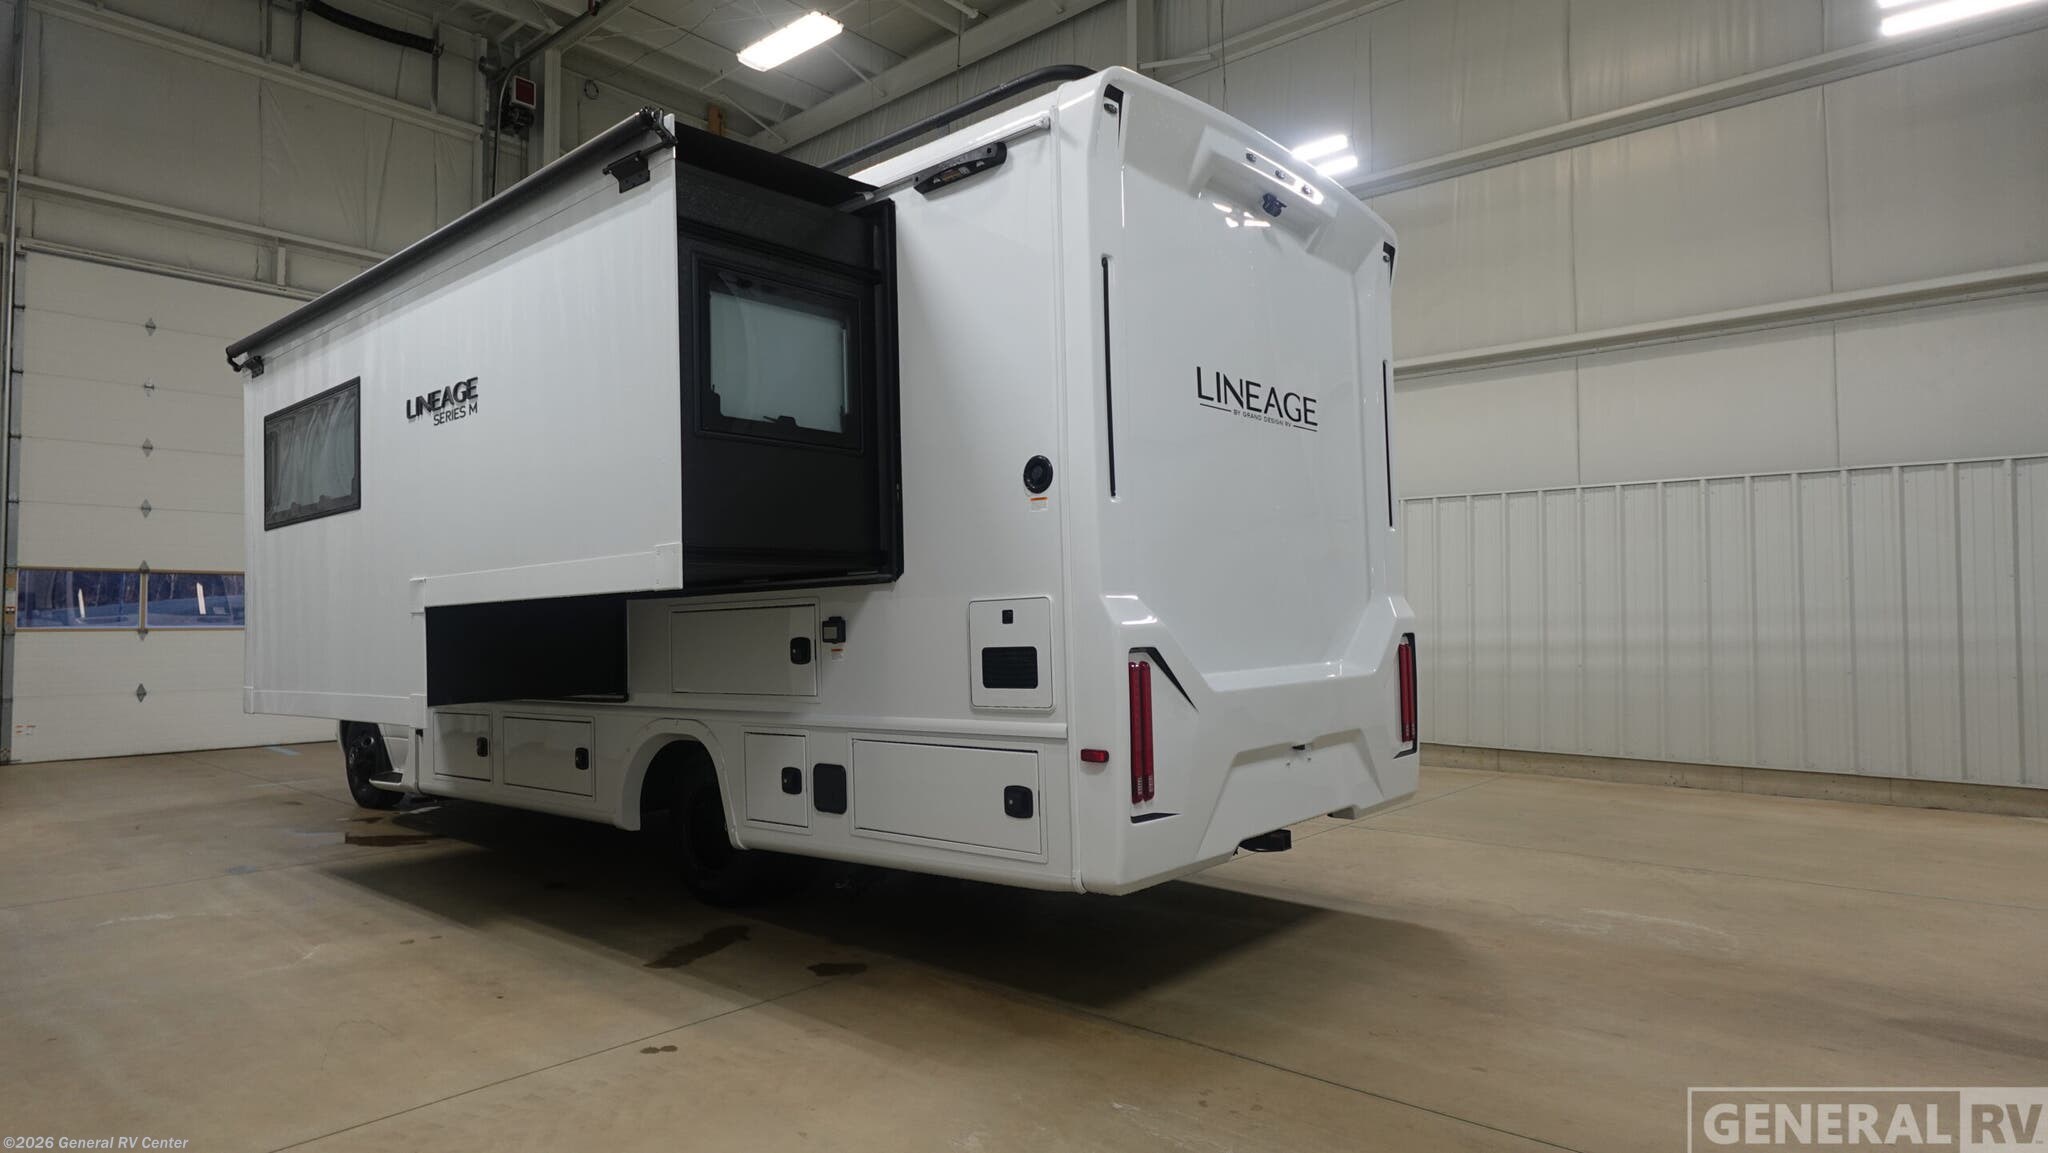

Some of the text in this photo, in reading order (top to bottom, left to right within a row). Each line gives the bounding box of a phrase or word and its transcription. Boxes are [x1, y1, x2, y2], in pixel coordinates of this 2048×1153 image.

[406, 376, 479, 420] LINEAGE
[433, 401, 478, 426] SERIES M
[1196, 366, 1318, 426] LINEAGE
